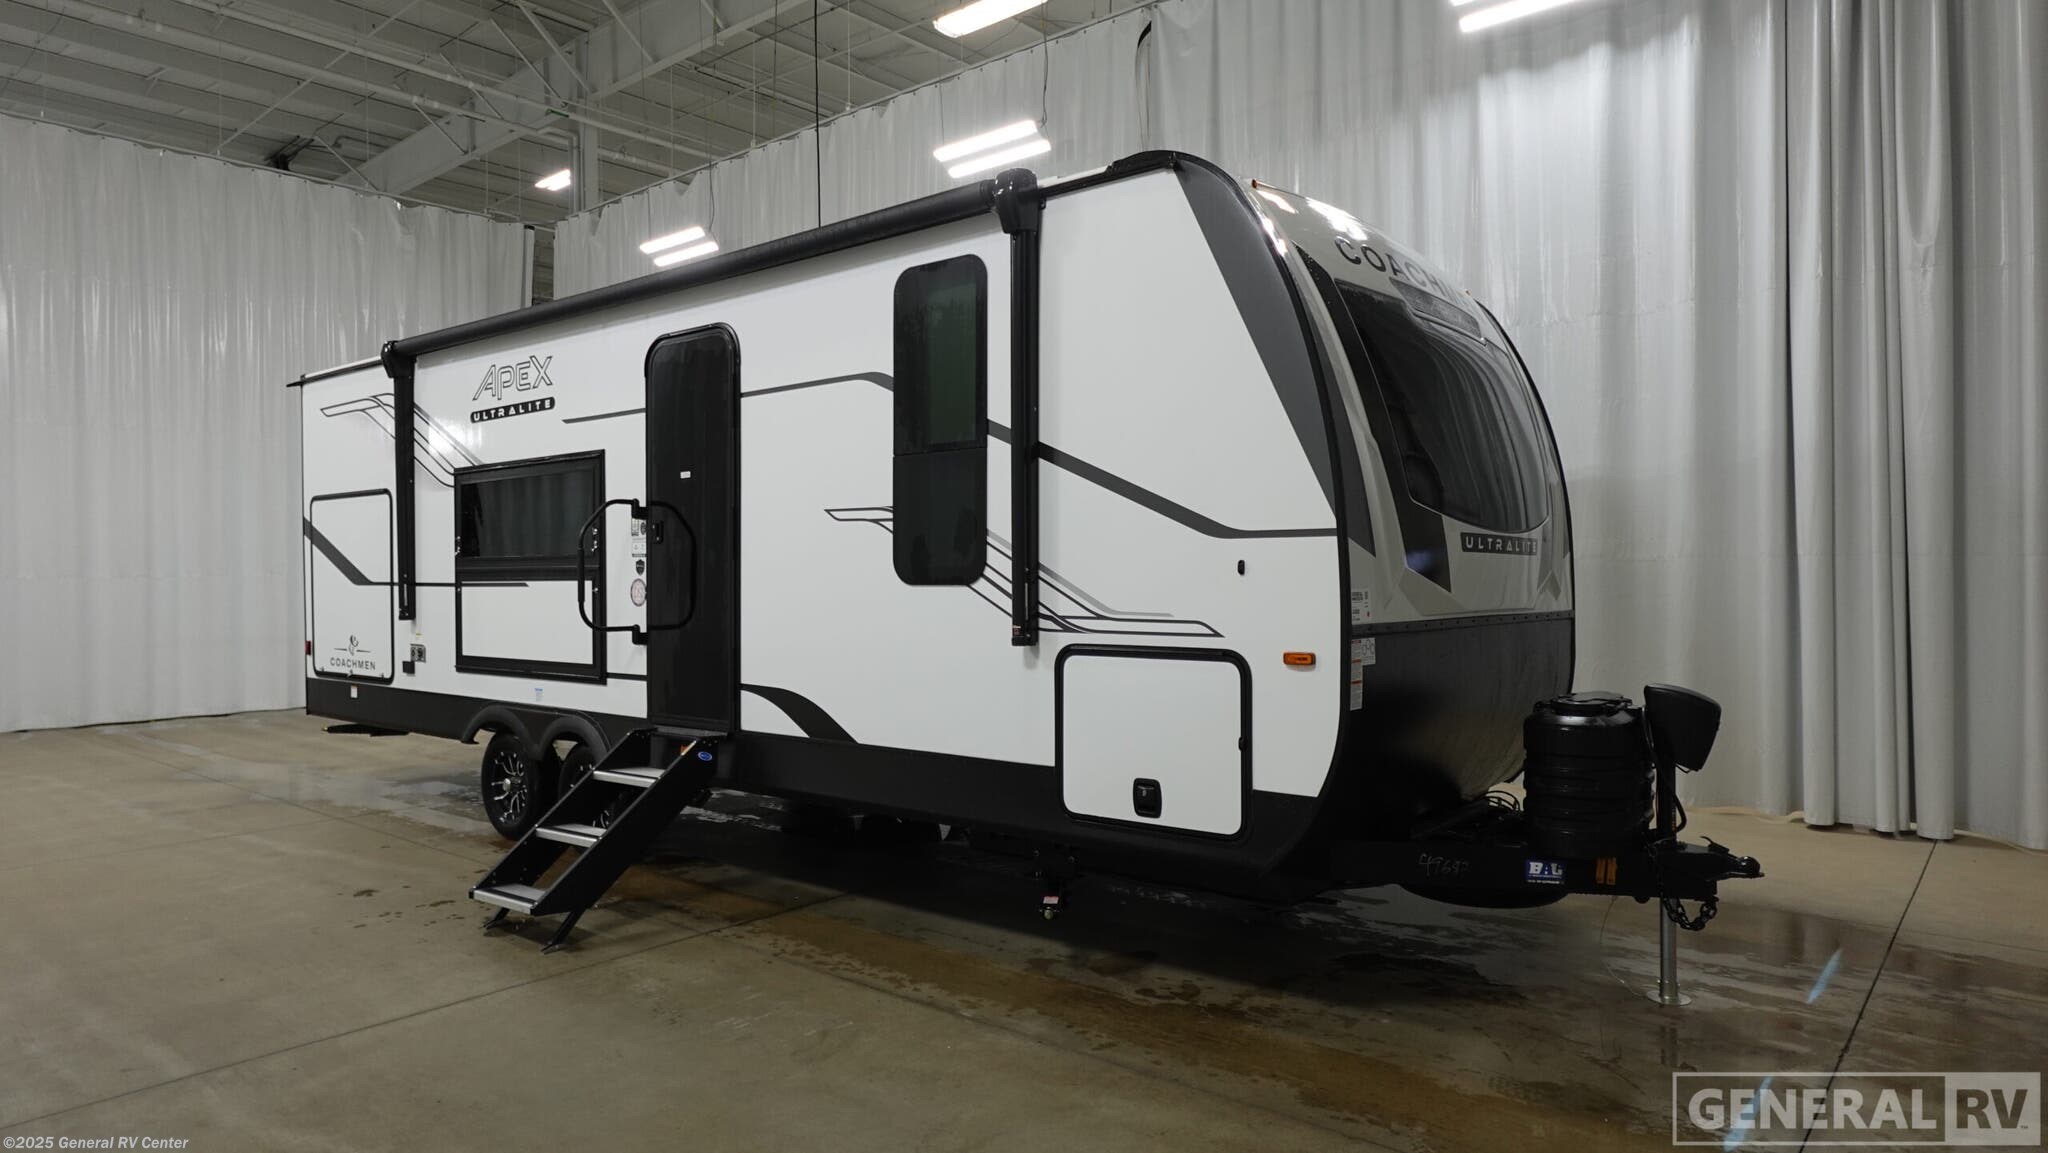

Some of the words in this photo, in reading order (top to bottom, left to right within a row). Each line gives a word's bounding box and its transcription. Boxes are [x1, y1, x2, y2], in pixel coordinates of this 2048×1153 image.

[472, 355, 553, 400] APEX
[473, 399, 551, 421] ULTRALITE
[1465, 535, 1537, 553] ULTRALITE
[330, 656, 376, 671] COACHMEN
